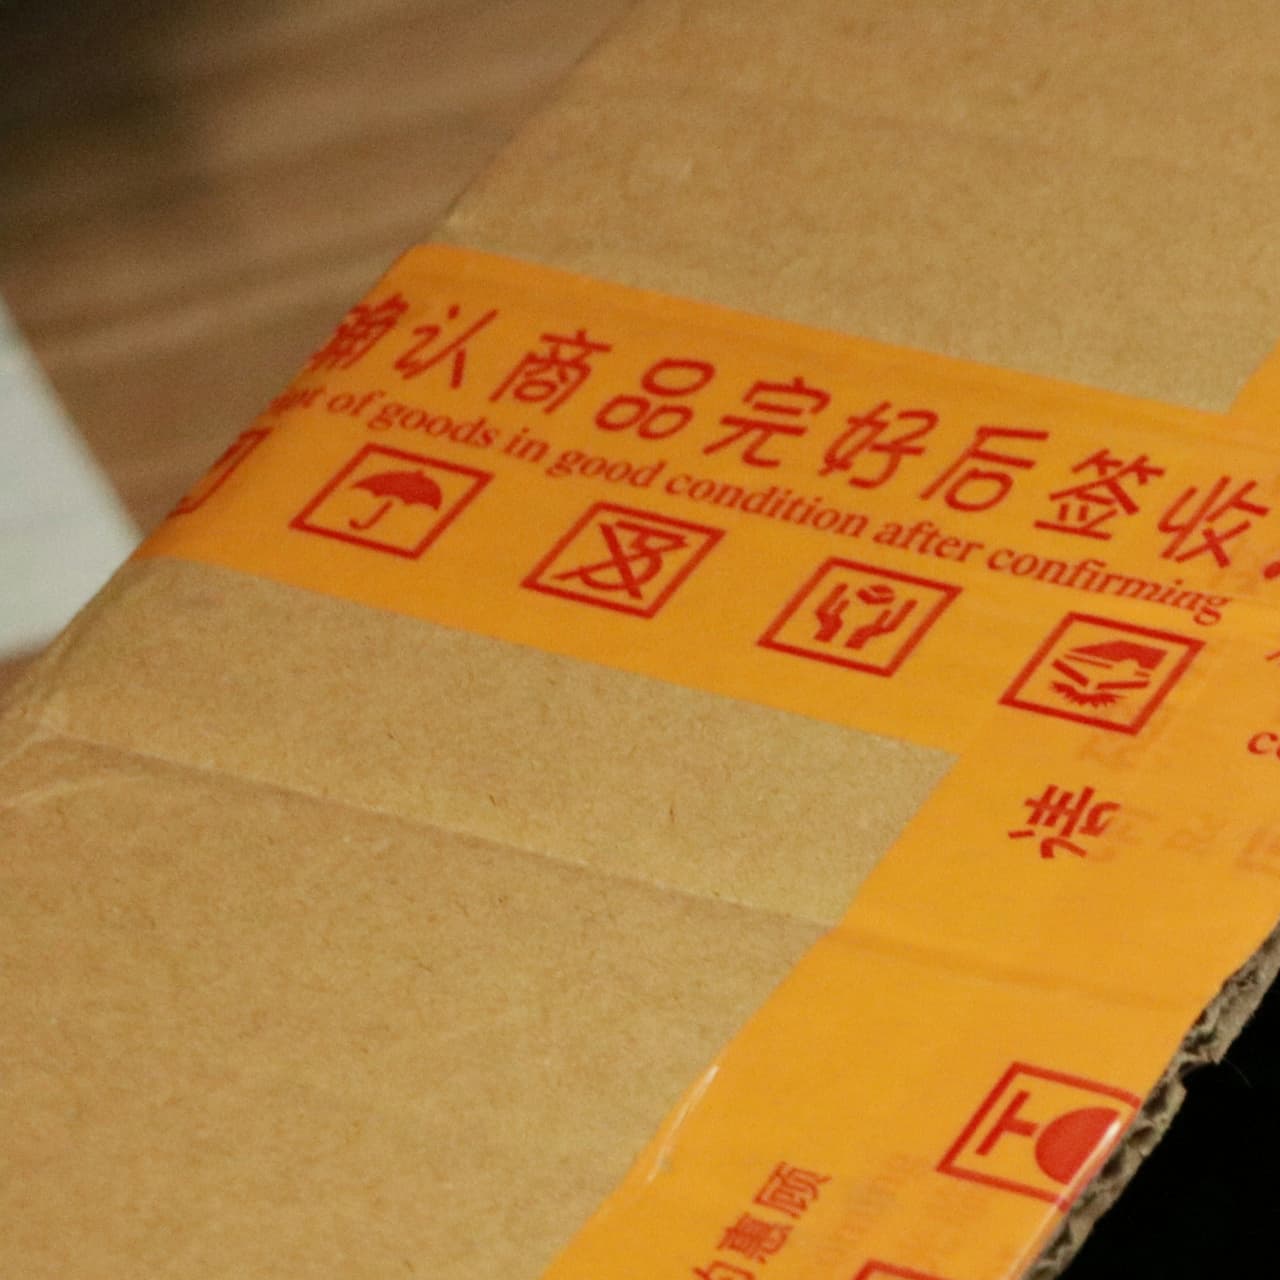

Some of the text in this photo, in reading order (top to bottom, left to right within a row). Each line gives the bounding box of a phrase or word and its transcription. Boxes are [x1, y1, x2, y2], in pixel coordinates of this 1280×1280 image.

[326, 389, 386, 418] of
[365, 401, 500, 448] goods
[502, 427, 551, 464] in
[545, 449, 668, 489] good
[664, 471, 870, 539] condition
[873, 520, 985, 564] after
[985, 550, 1237, 628] confirming
